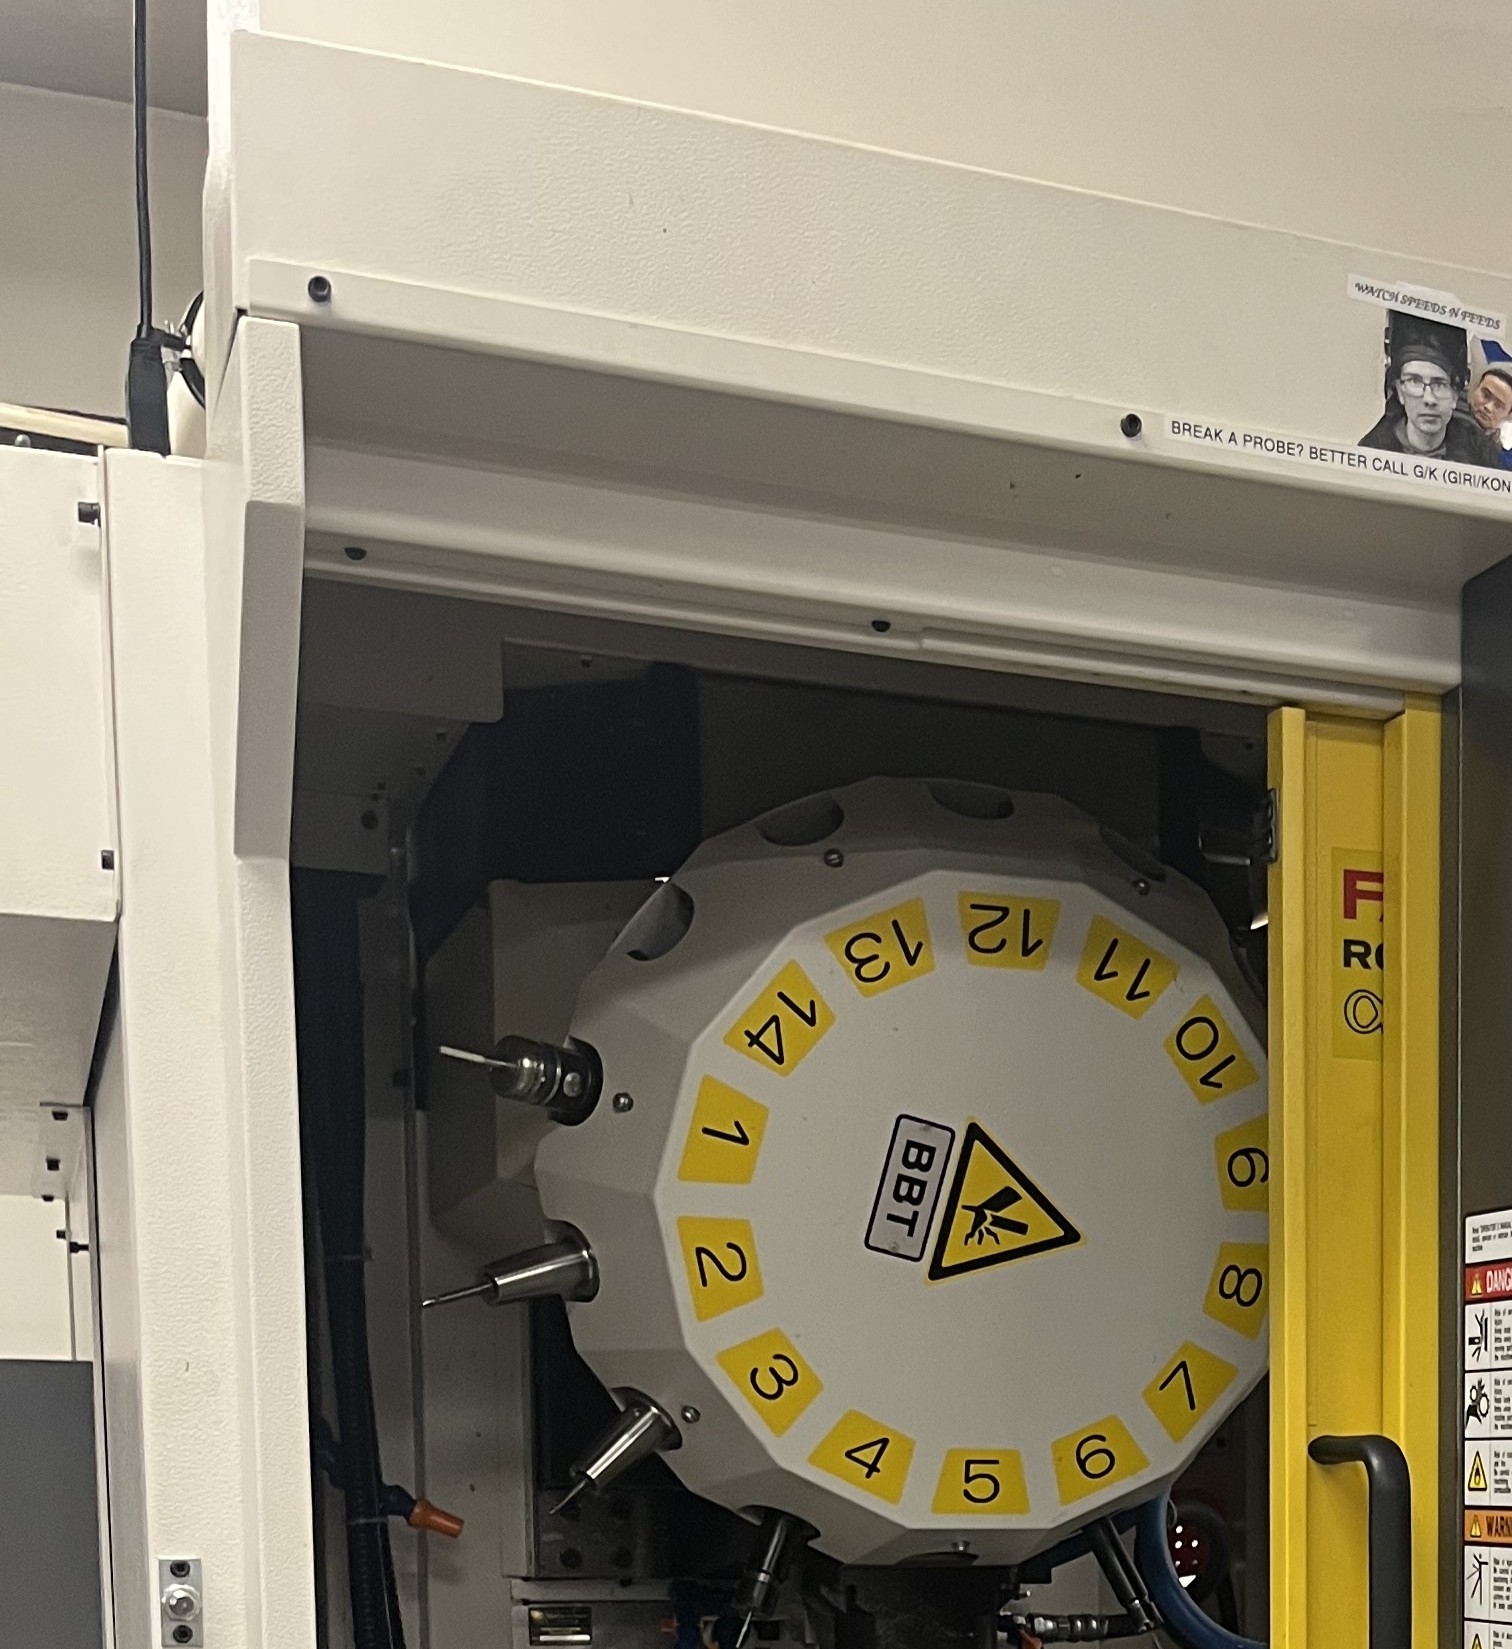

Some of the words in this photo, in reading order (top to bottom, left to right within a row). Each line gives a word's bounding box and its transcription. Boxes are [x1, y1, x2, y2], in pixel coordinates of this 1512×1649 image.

[1354, 282, 1400, 303] WATCH
[1400, 295, 1447, 316] SPEEDS
[1460, 310, 1501, 330] FEEDS
[1171, 420, 1223, 443] BREAK
[1228, 431, 1238, 445] A
[1243, 434, 1305, 457] PROBE?
[1309, 446, 1367, 469] BETTER
[1372, 458, 1408, 477] CALL
[1413, 465, 1438, 481] G/K
[843, 918, 925, 984] 13
[967, 902, 1045, 959] 12
[1094, 937, 1152, 1002] 11
[743, 990, 819, 1066] 14
[1174, 1015, 1238, 1090] 10
[701, 1119, 751, 1147] 1
[886, 1139, 937, 1238] BBT
[694, 1242, 748, 1288] 2
[1218, 1265, 1262, 1308] 8
[749, 1353, 800, 1401] 3
[1158, 1360, 1198, 1411] 7
[844, 1436, 891, 1481] 4
[961, 1457, 1001, 1504] 5
[1074, 1433, 1116, 1481] 6
